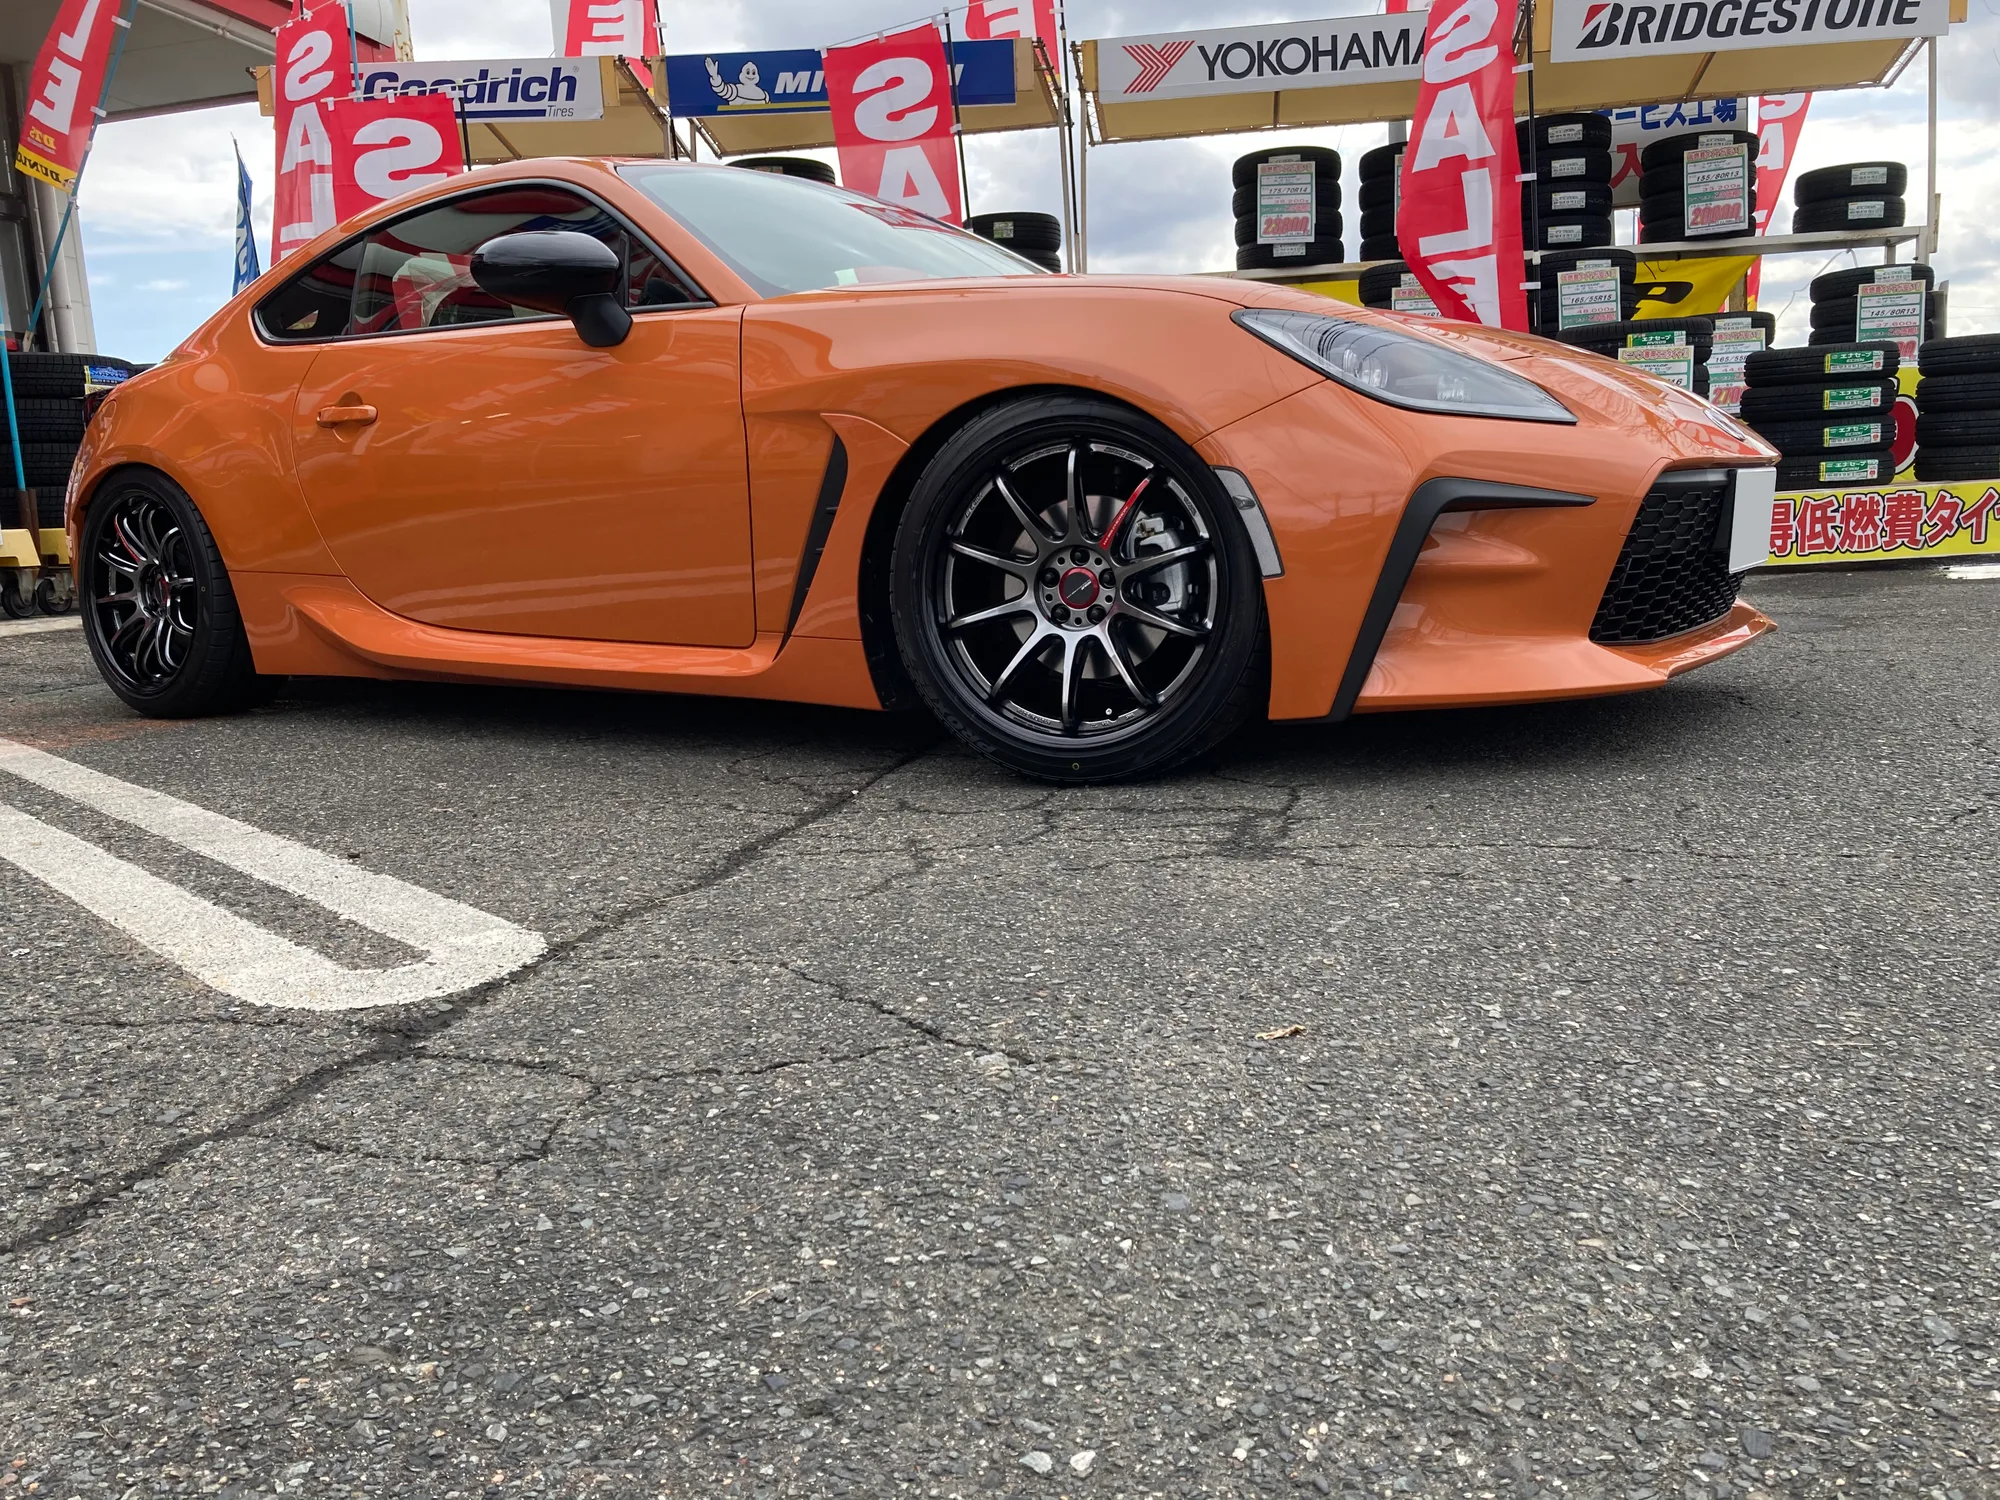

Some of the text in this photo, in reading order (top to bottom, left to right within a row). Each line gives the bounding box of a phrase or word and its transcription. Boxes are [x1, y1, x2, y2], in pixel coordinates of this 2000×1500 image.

[1576, 0, 1922, 49] BRIDGESTONE
[1197, 27, 1425, 81] YOKOHAM
[547, 105, 574, 117] Tires
[1592, 98, 1737, 130] ービス工場
[1571, 294, 1612, 303] 165/55R15
[1870, 308, 1916, 316] 145/80R13
[1642, 334, 1672, 342] エナセーブ
[1840, 351, 1872, 359] エナセーブ
[1839, 388, 1870, 396] エナセーブ
[1839, 425, 1870, 433] エナセーブ
[1834, 460, 1867, 468] エナセーブ
[1770, 488, 2000, 556] 得低燃費タイ
